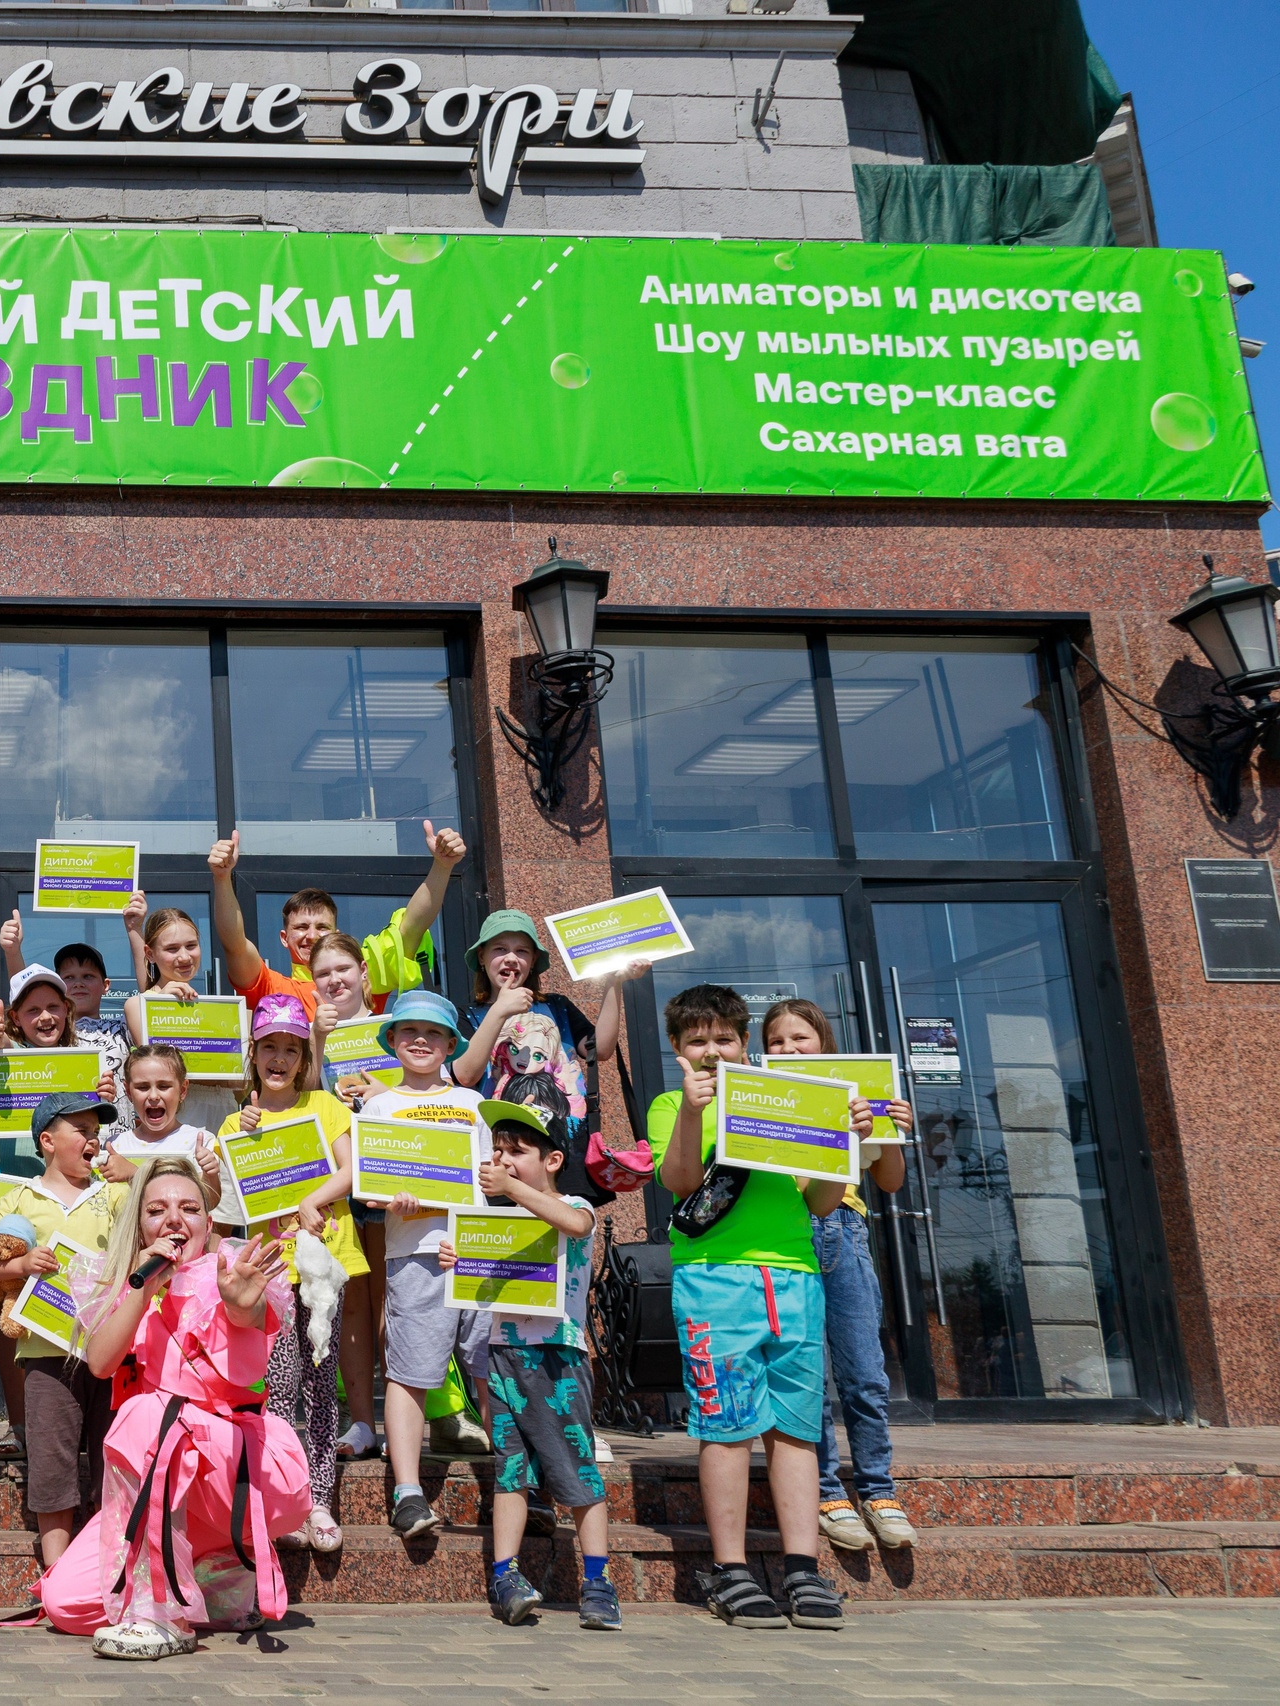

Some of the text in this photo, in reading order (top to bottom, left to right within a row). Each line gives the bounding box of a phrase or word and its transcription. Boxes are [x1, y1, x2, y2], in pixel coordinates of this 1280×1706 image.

[345, 58, 646, 201] Зори
[639, 275, 1142, 316] Аниматоры и дискотека
[61, 273, 415, 348] ДЕТСКИЙ
[655, 323, 1141, 369] Шоу мыльных пузырей
[754, 373, 1056, 413] Мастер-класс
[759, 422, 1067, 462] Сахарная вата
[731, 1090, 795, 1109] ДИПЛОМ
[730, 1125, 796, 1140] ЮНОМУ КОНДИТЕРУ
[731, 1118, 836, 1139] ВЫДАН САМОМУ ТАЛАНТЛИВОМУ
[363, 1136, 422, 1151] ДИПЛОМ
[459, 1232, 513, 1245] ДИПЛОМ
[477, 1262, 501, 1270] САМОМУ
[502, 1264, 547, 1273] ТАЛАНТЛИВОМУ
[479, 1269, 511, 1277] КОНДИТЕРУ
[36, 1289, 61, 1306] ЮНОМУ
[39, 1284, 62, 1300] ВЫДАН
[686, 1317, 722, 1417] HEAT
